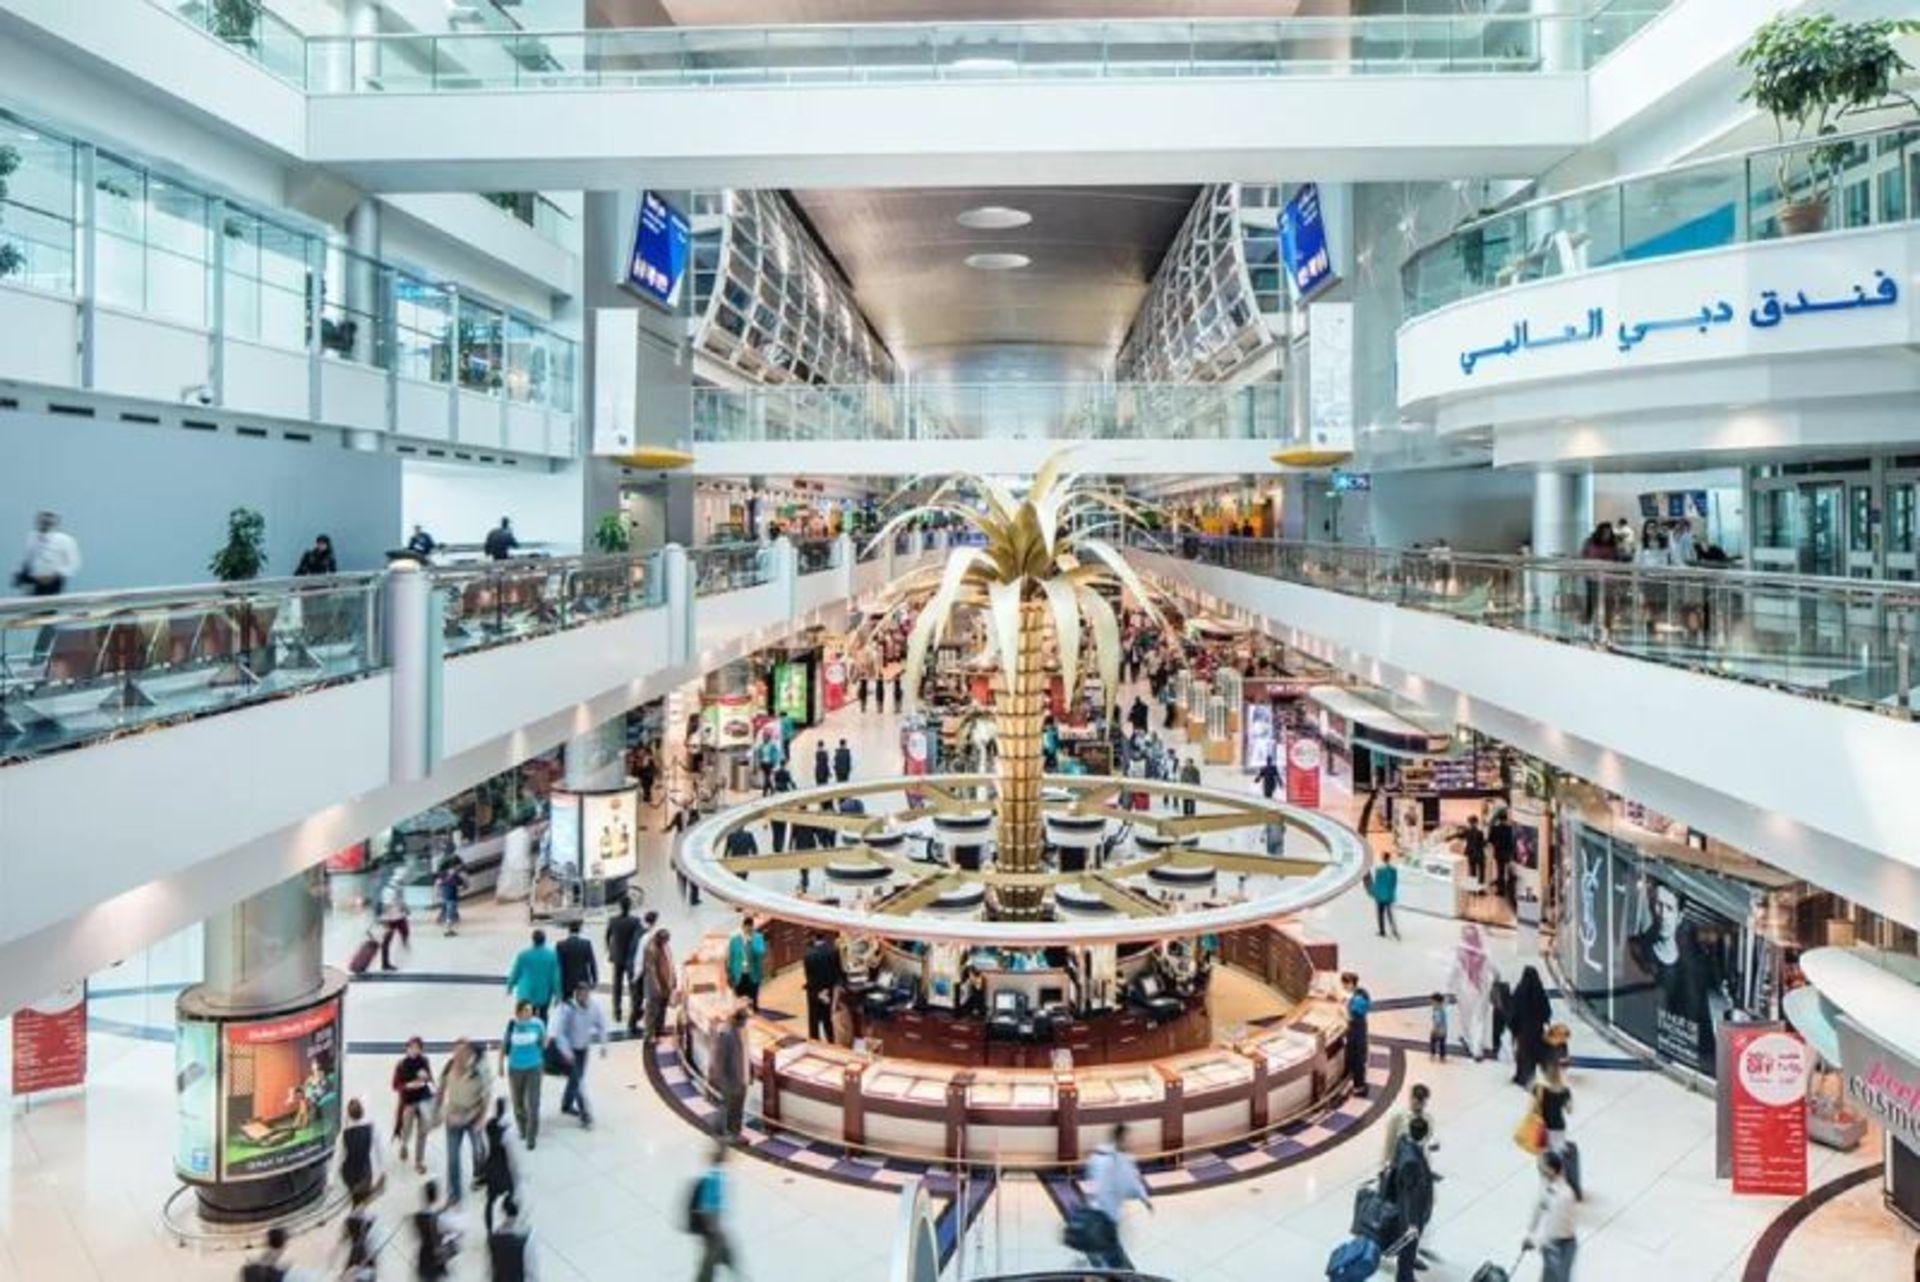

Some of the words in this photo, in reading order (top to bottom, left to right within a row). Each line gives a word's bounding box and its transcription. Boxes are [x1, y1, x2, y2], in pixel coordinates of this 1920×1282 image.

[1618, 301, 1734, 352] دبي
[1749, 269, 1898, 328] فندق
[1460, 307, 1604, 375] العالمي
